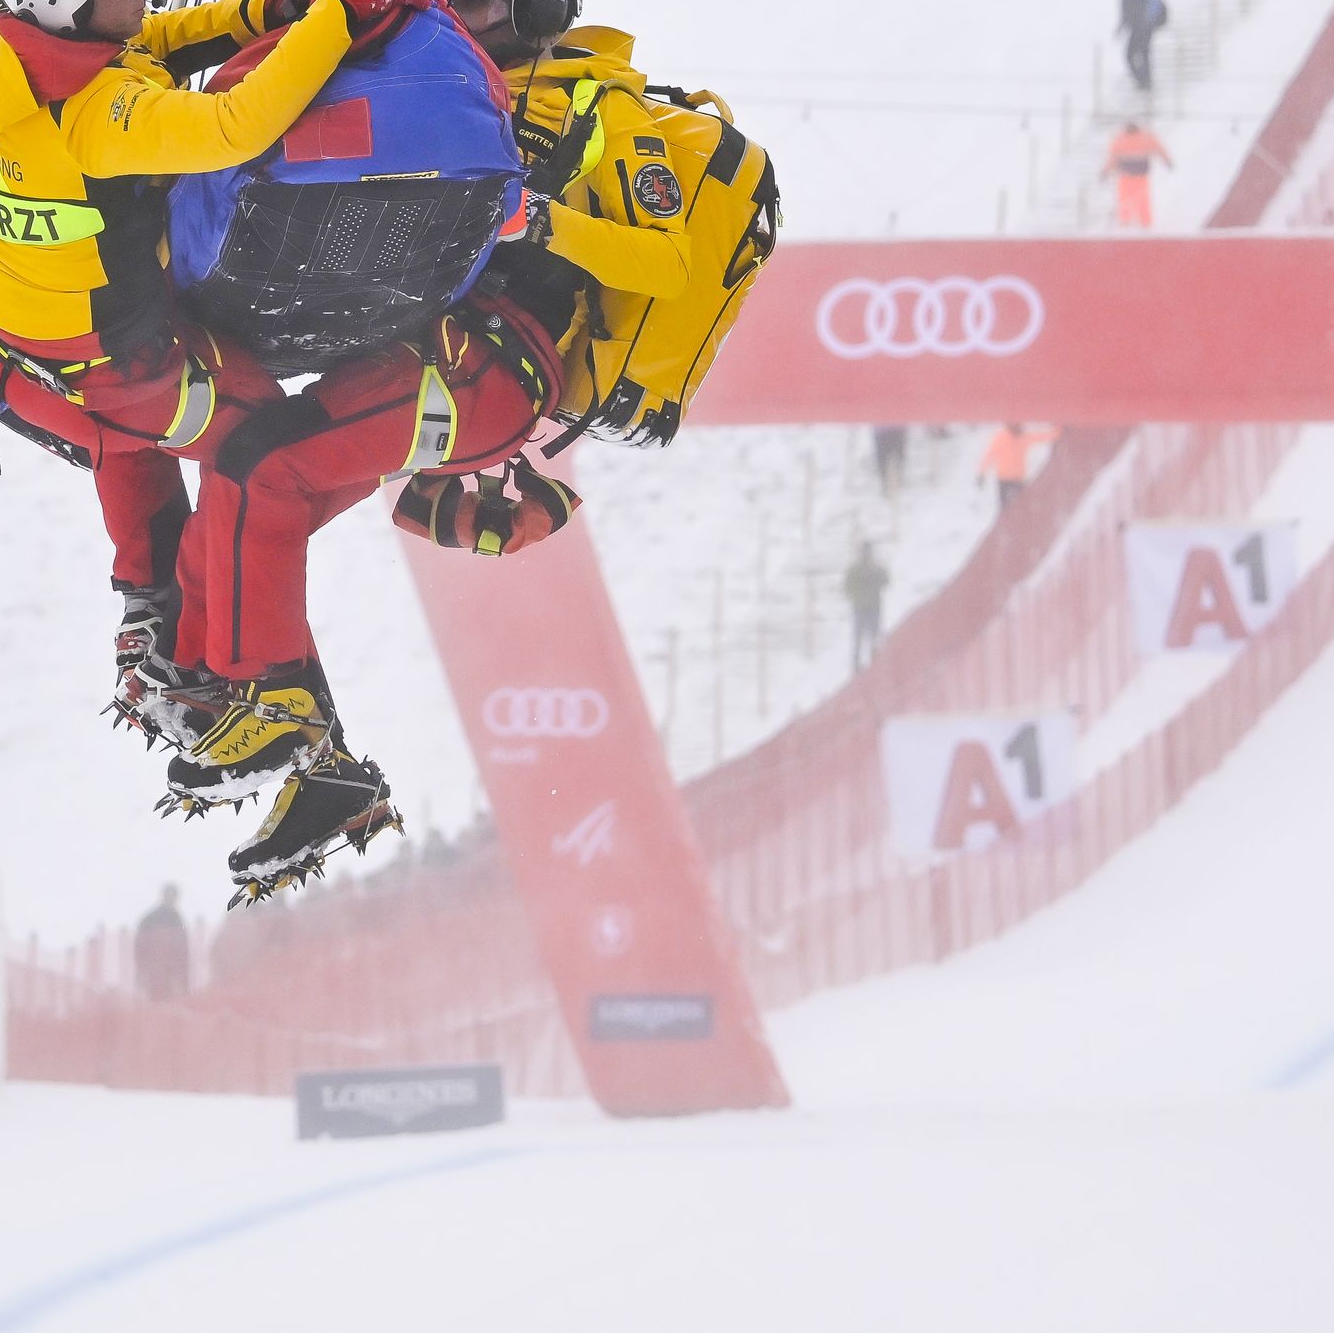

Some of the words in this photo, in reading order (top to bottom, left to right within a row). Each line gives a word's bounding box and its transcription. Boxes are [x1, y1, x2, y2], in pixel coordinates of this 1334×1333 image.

[518, 128, 554, 150] GRETTER
[1163, 532, 1269, 649] A1
[932, 721, 1044, 852] A1
